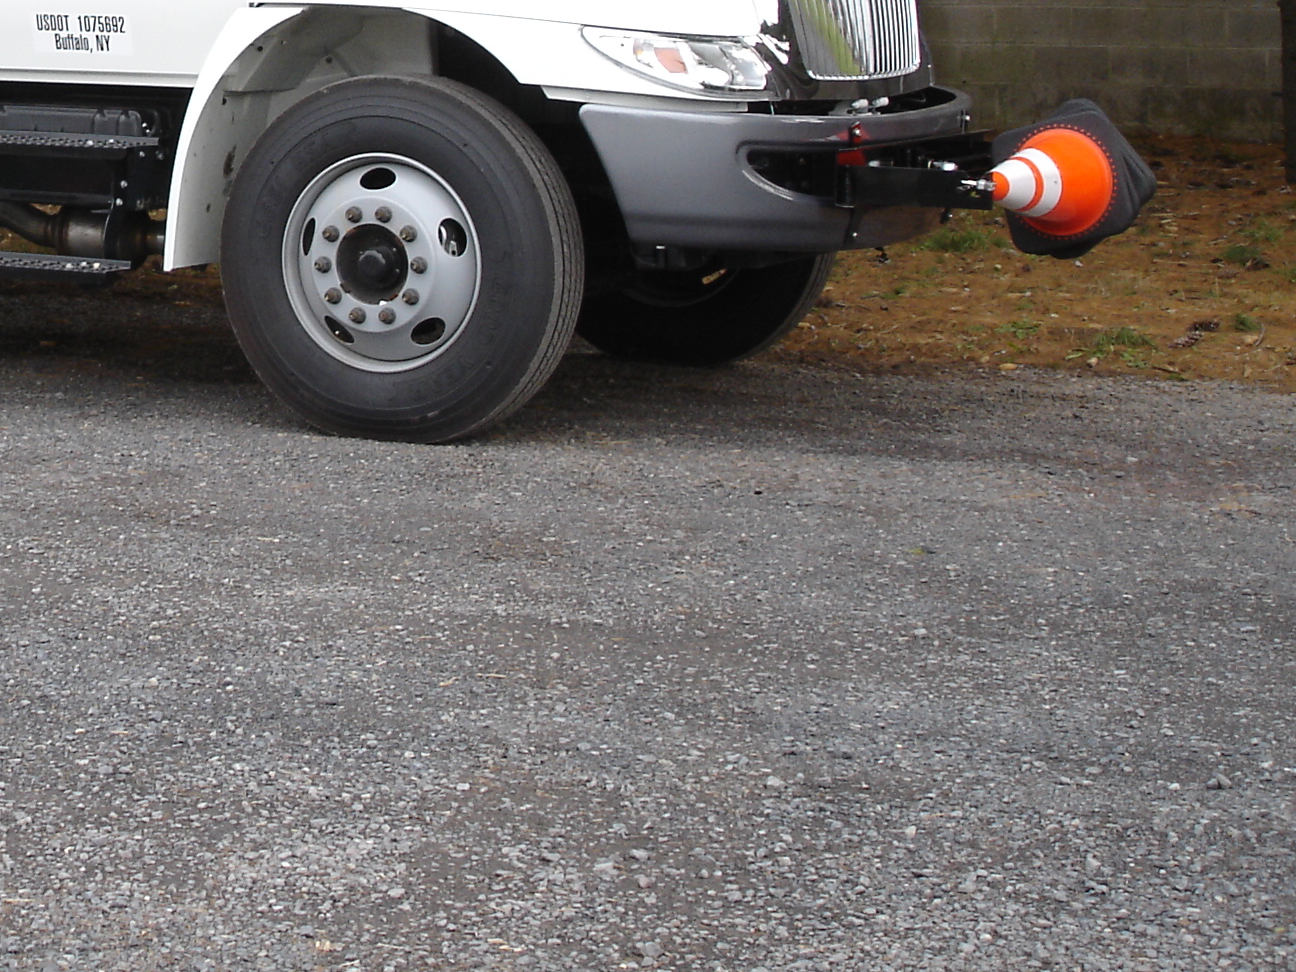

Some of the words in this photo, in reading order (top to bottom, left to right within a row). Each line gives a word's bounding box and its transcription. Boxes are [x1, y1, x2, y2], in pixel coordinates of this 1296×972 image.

[36, 14, 69, 31] USDOT
[77, 15, 126, 33] 1075692
[54, 33, 93, 53] Buffalo,
[95, 34, 110, 52] NY
